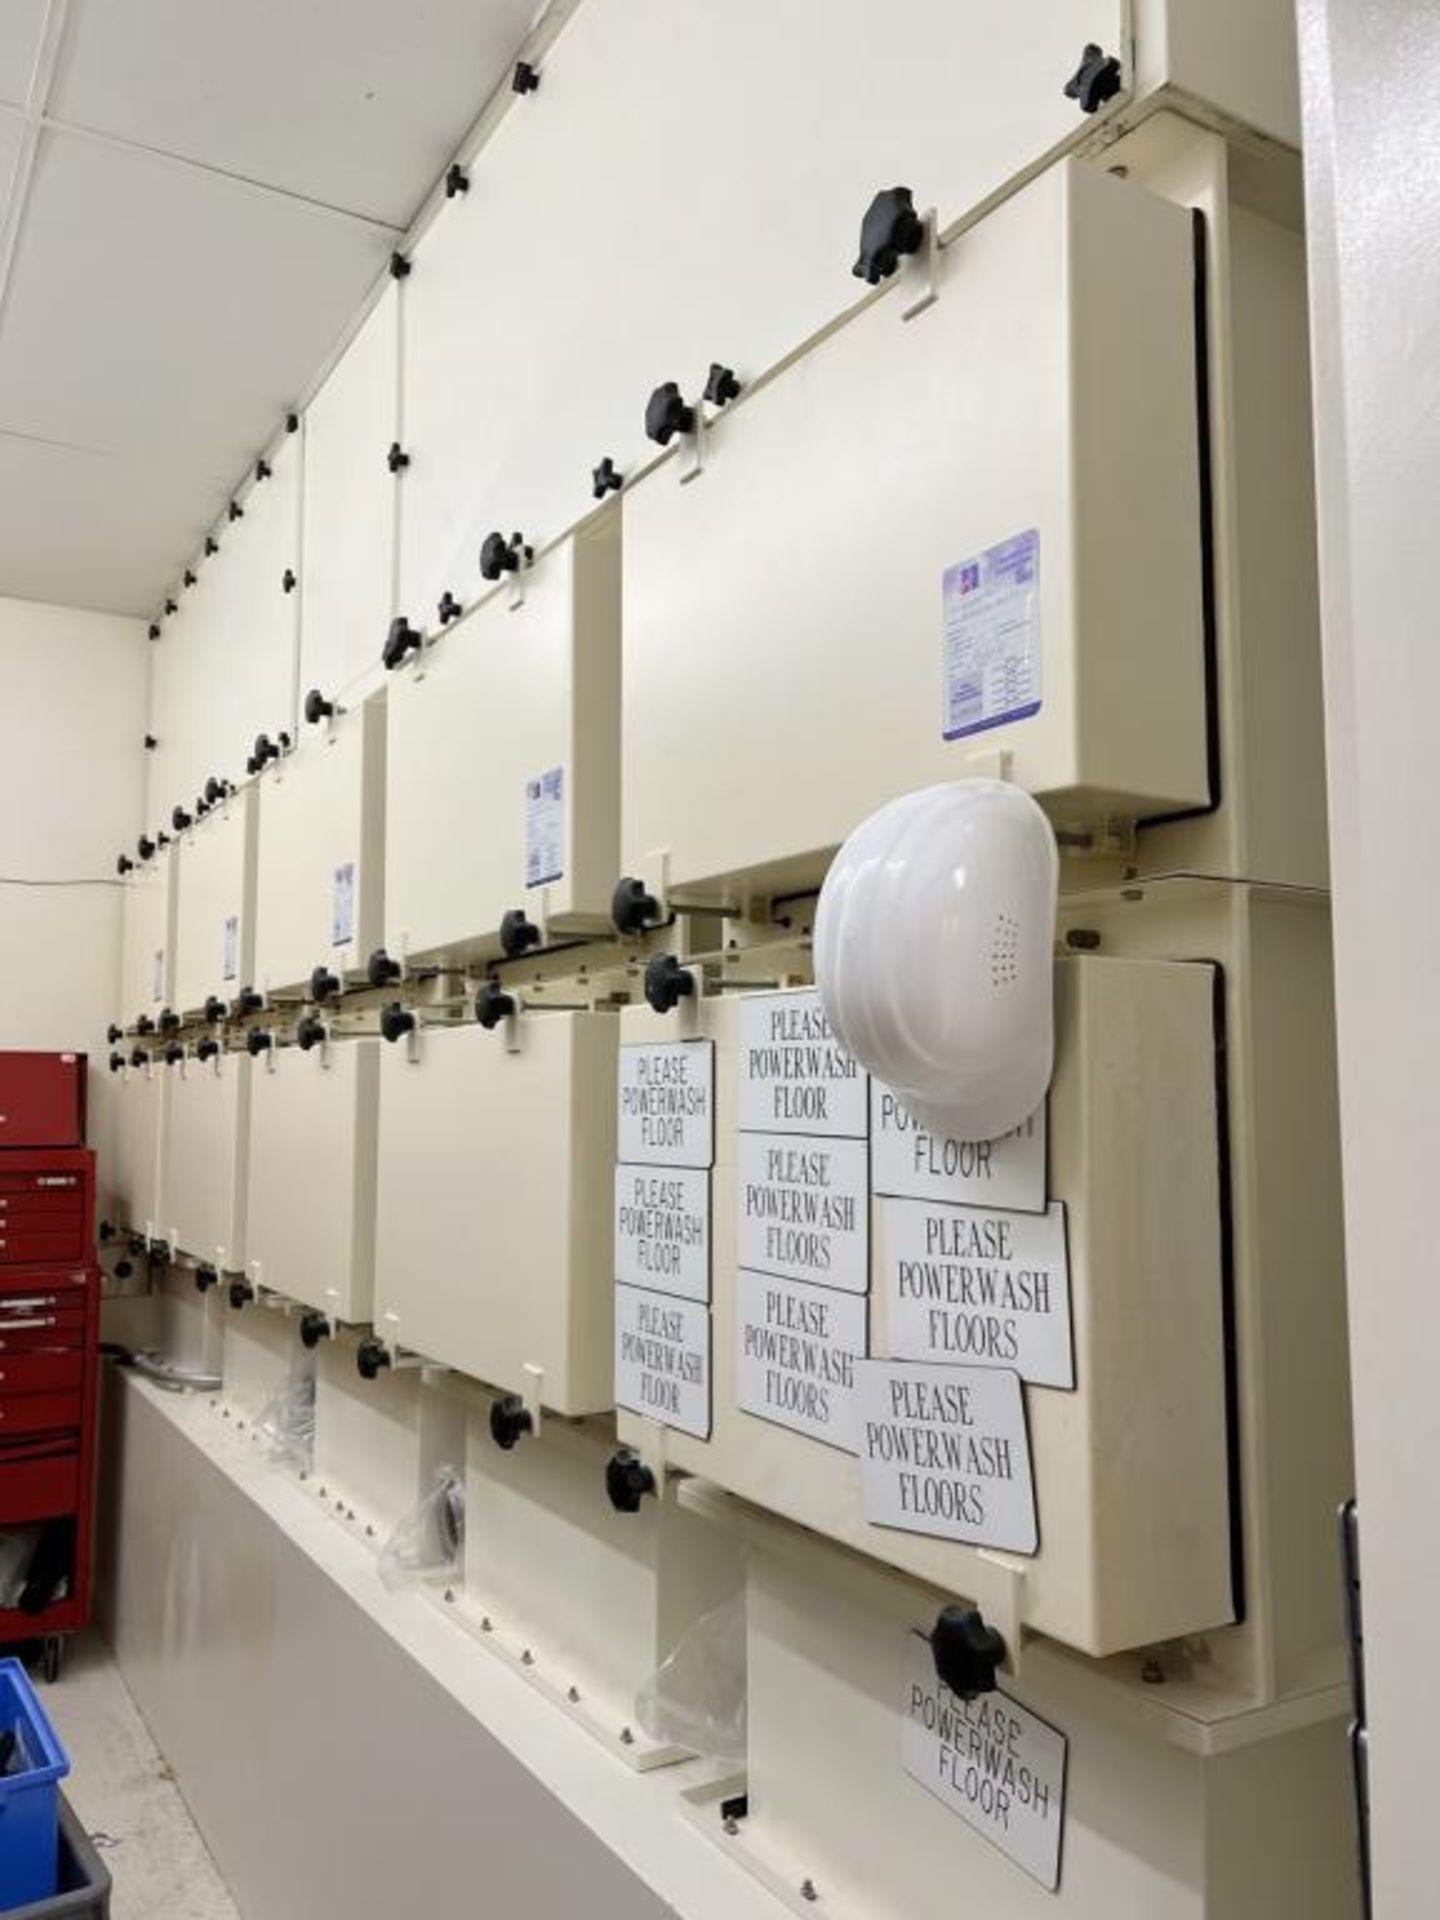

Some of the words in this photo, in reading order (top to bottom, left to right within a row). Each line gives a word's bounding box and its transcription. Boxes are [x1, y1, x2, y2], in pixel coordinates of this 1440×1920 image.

[639, 1055, 688, 1085] PLEASE
[749, 1047, 857, 1079] POWERWASH
[623, 1087, 706, 1116] POWERWASH
[774, 1086, 829, 1119] FLOOR
[642, 1117, 684, 1147] FLOOR
[768, 1149, 831, 1186] PLEASE
[914, 1135, 992, 1179] FLOOR
[635, 1178, 684, 1210] PLEASE
[746, 1184, 855, 1231] POWERWASH
[620, 1207, 703, 1246] POWERWASH
[767, 1227, 831, 1268] FLOORS
[926, 1217, 1013, 1260] PLEASE
[638, 1239, 681, 1276] FLOOR
[898, 1260, 1051, 1313] POWERWASH
[638, 1303, 684, 1343] PLEASE
[766, 1292, 829, 1338] PLEASE
[929, 1309, 1019, 1360] FLOORS
[622, 1332, 703, 1385] POWERWASH
[744, 1324, 854, 1389] POWERWASH
[640, 1372, 681, 1415] FLOOR
[766, 1369, 829, 1423] FLOORS
[889, 1379, 974, 1426] PLEASE
[866, 1421, 1013, 1480] POWERWASH
[899, 1471, 985, 1526] FLOORS
[911, 1684, 1048, 1818] POWERWASH
[939, 1743, 1010, 1830] FLOOR
